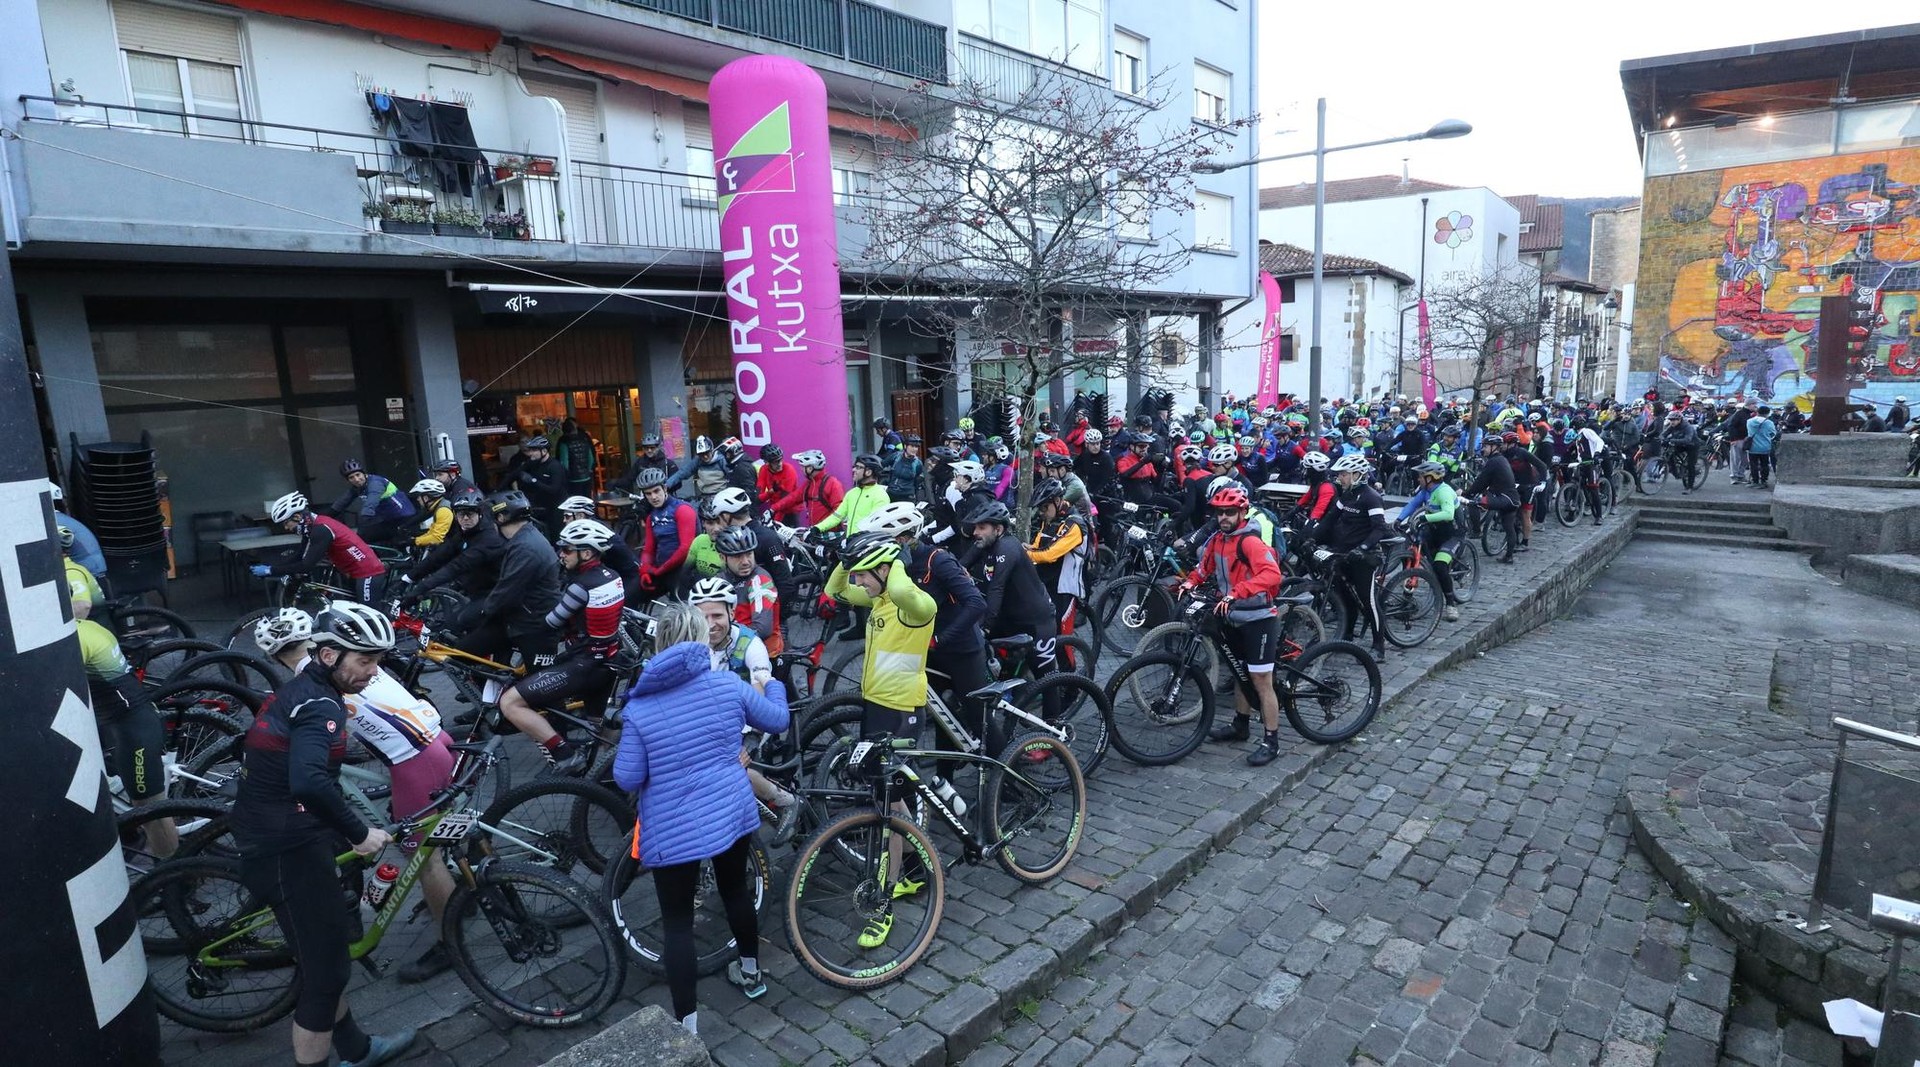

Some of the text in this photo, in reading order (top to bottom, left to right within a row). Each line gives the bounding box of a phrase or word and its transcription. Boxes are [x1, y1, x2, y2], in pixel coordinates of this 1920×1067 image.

[768, 223, 808, 353] kutxa
[1441, 270, 1466, 281] aire
[505, 294, 538, 312] 18/70
[533, 654, 555, 666] FOX
[354, 715, 391, 741] Azpiru
[136, 747, 146, 794] ORBEA
[433, 823, 468, 839] 312
[756, 850, 769, 890] MAXXIS
[377, 851, 426, 928] SANTA CRUZ
